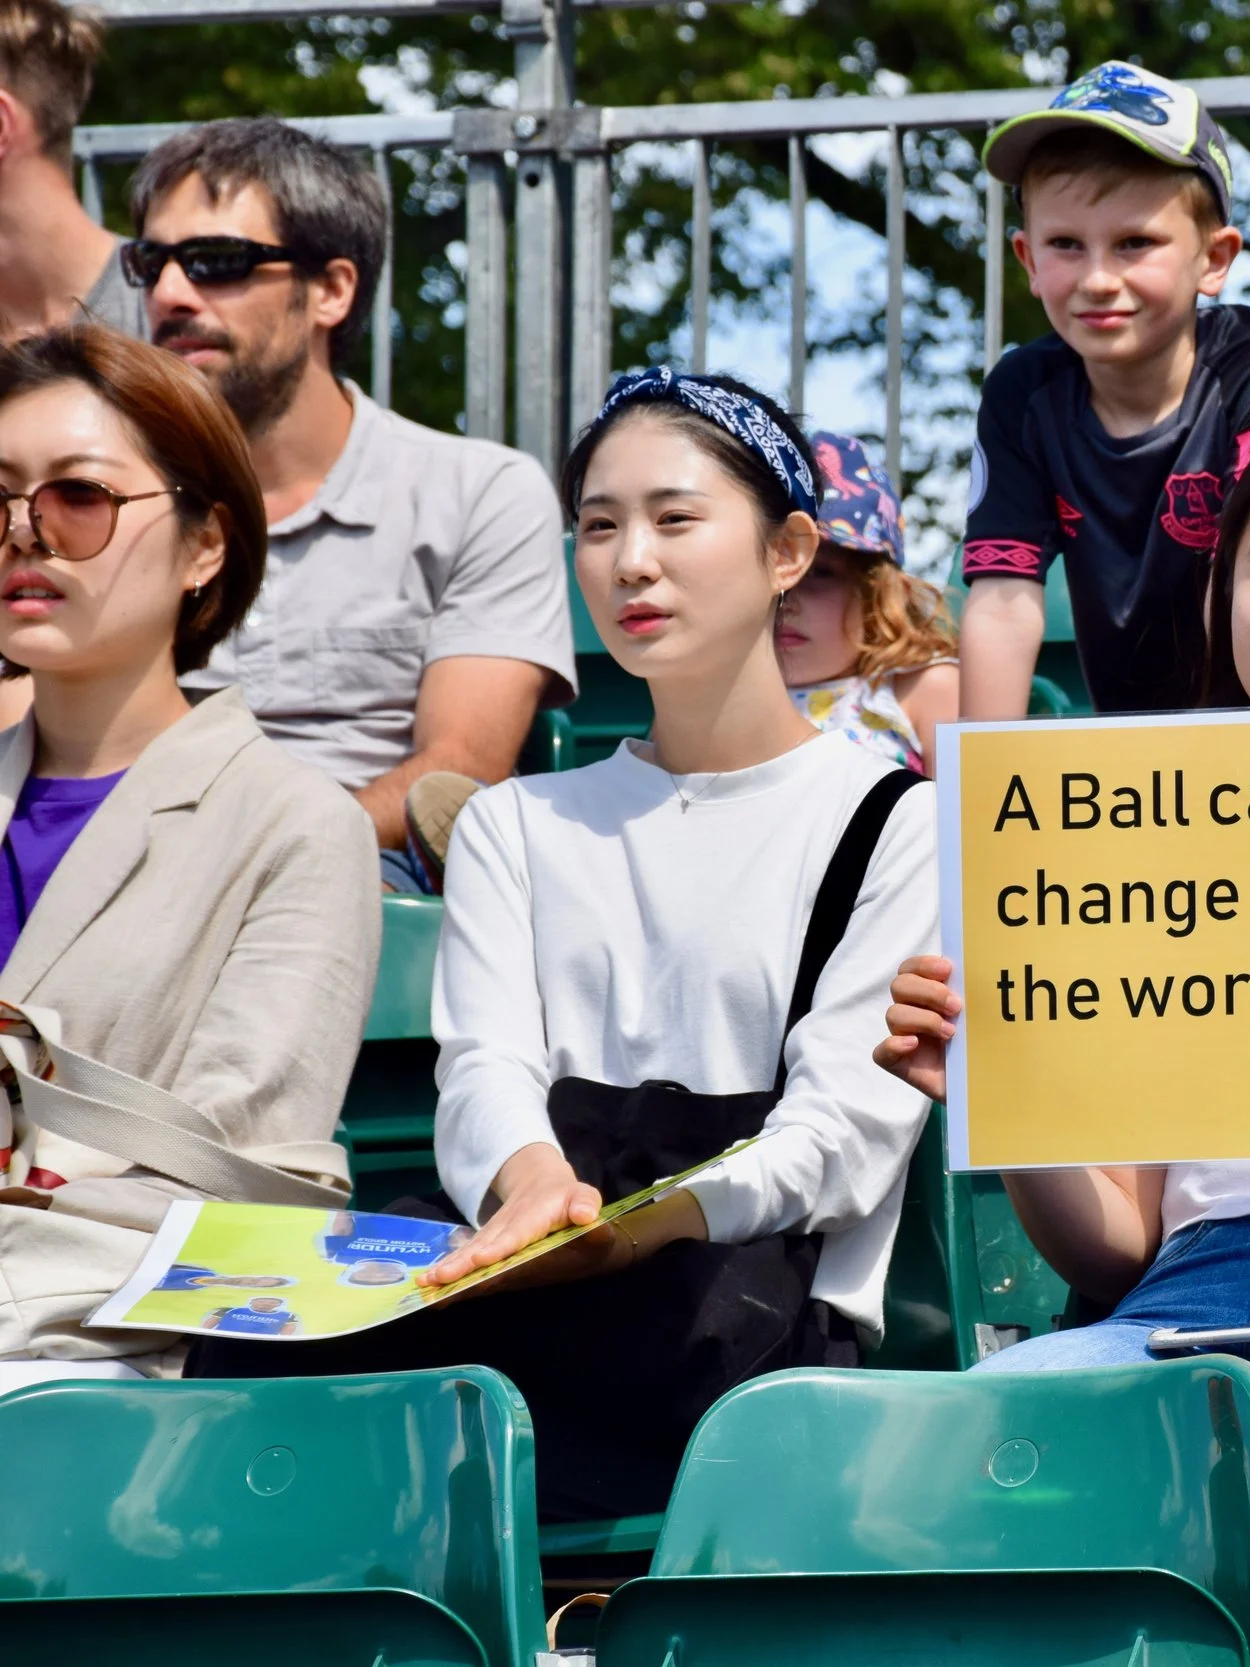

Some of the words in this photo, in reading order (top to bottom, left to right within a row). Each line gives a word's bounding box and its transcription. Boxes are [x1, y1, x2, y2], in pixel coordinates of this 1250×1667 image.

[994, 774, 1041, 833] A
[1061, 769, 1190, 830] Ball
[996, 868, 1240, 938] change
[996, 963, 1101, 1023] the
